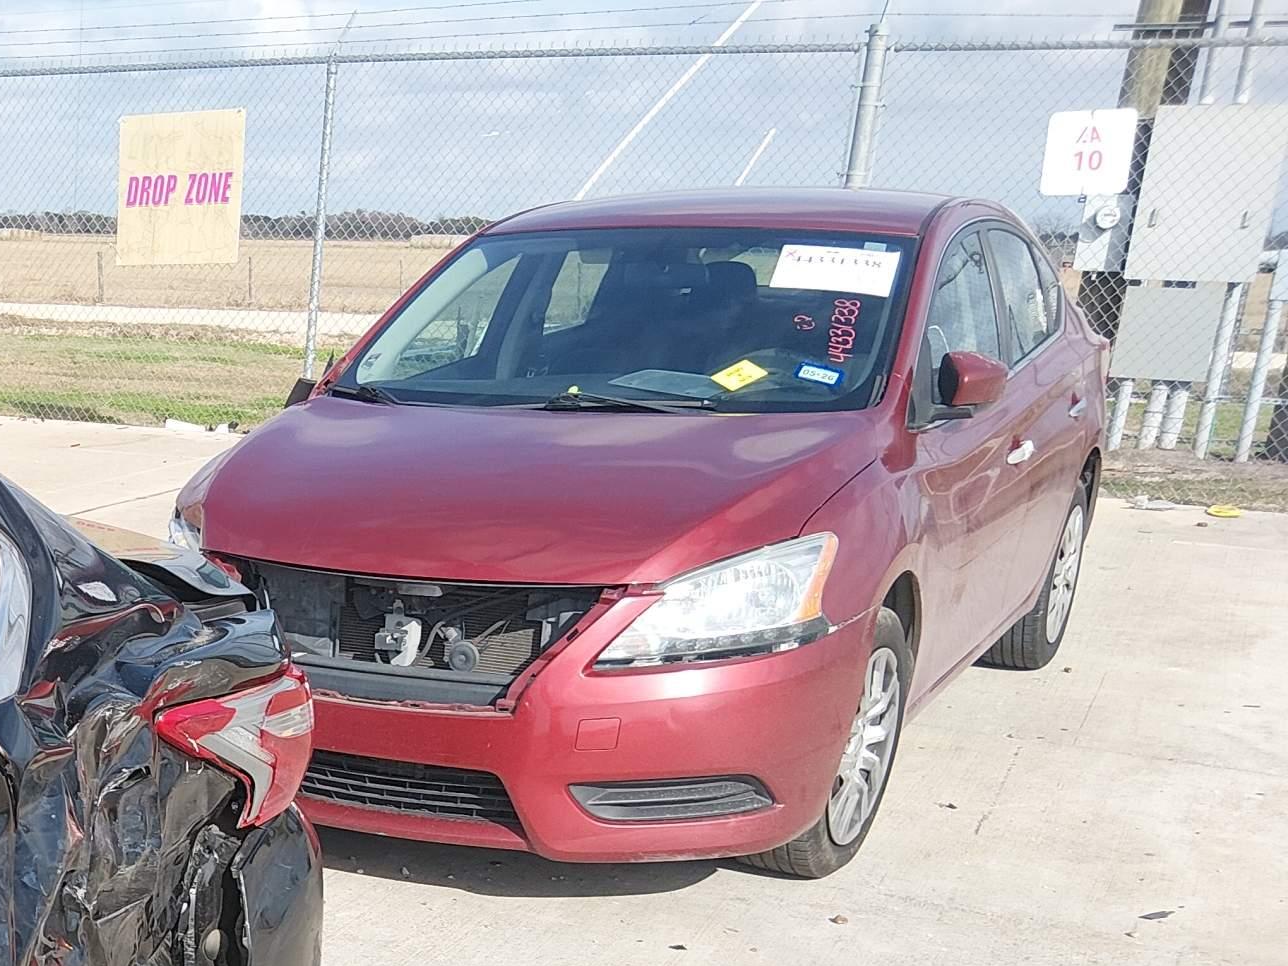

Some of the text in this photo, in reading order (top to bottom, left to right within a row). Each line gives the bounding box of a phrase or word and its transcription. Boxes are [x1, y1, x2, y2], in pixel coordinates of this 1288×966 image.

[1074, 150, 1103, 171] 10
[126, 172, 233, 208] DROP ZONE
